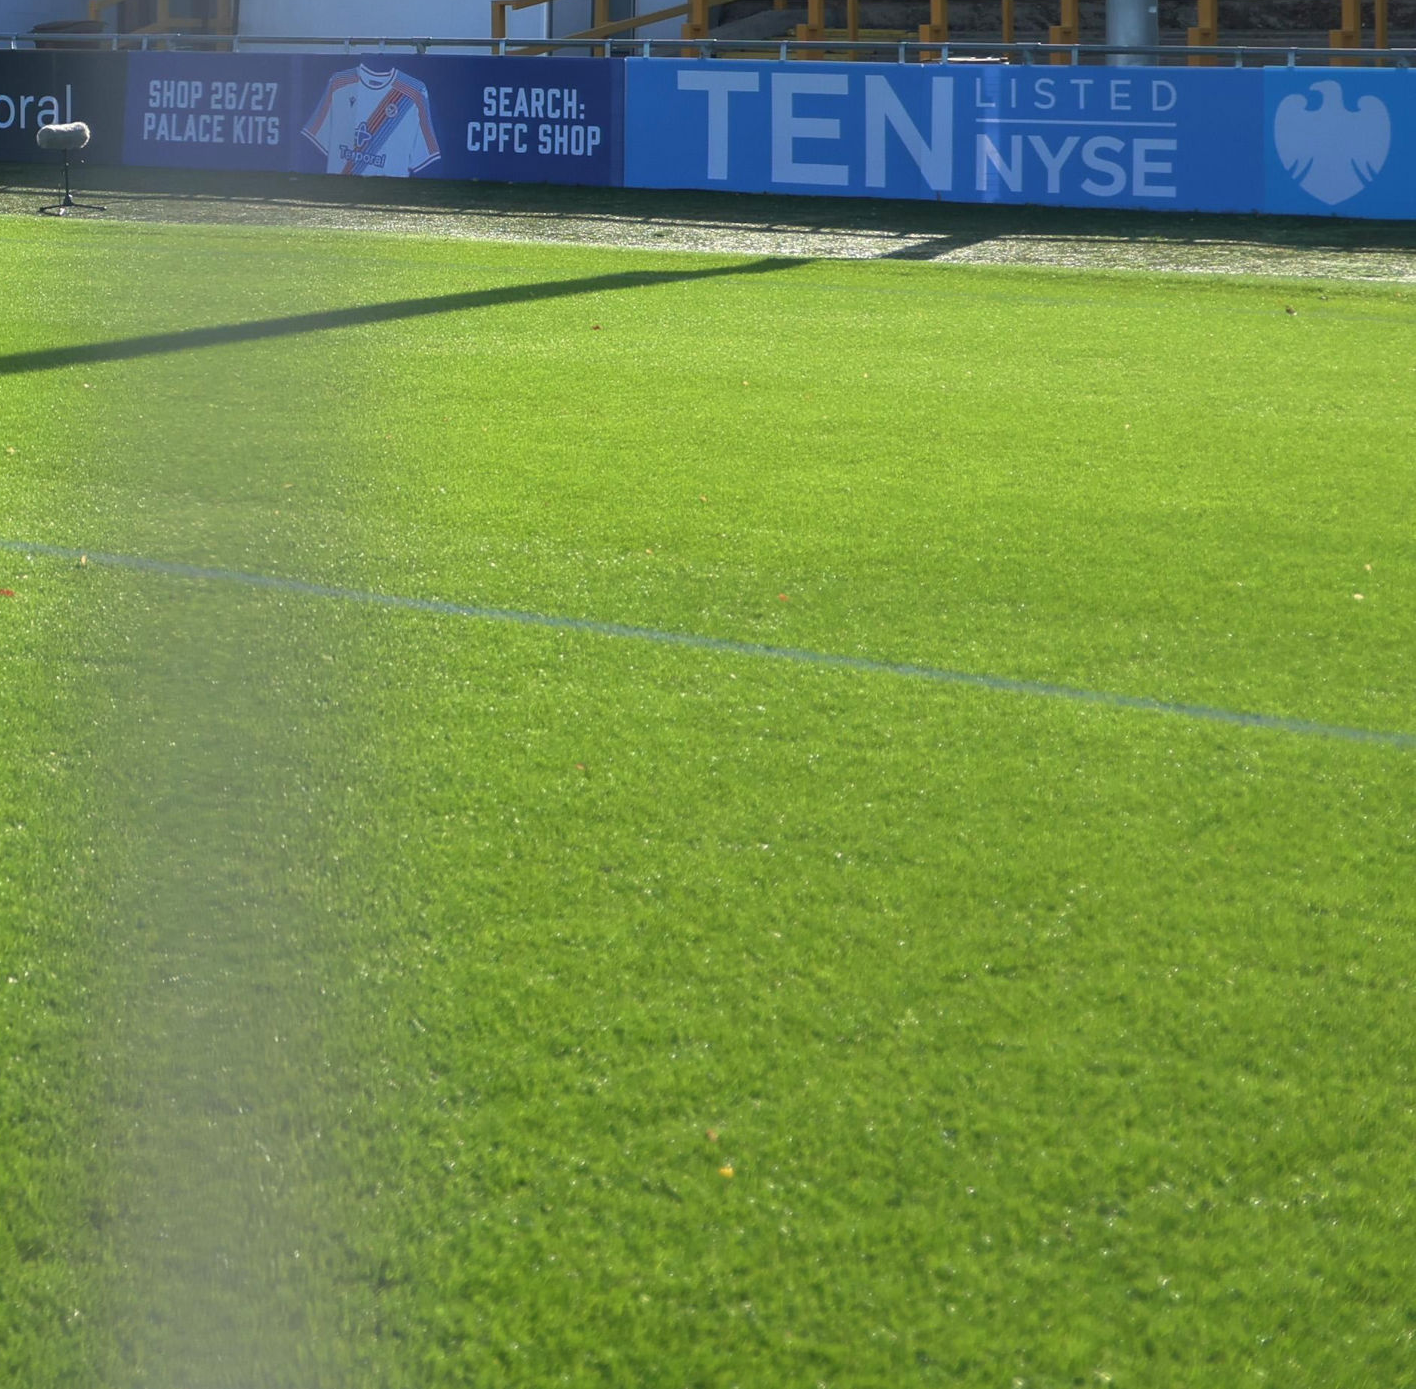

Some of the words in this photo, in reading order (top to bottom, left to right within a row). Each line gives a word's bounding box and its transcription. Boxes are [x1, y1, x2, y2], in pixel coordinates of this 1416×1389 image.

[148, 79, 202, 110] SHOP
[210, 82, 279, 112] 26/27
[482, 86, 586, 120] SEARCH:
[975, 77, 1177, 112] LISTED
[143, 113, 223, 143] PALACE
[232, 115, 280, 145] KITS
[467, 121, 528, 153] CPFC
[538, 124, 601, 156] SHOP
[677, 70, 954, 191] TEN
[975, 133, 1177, 198] NYSE
